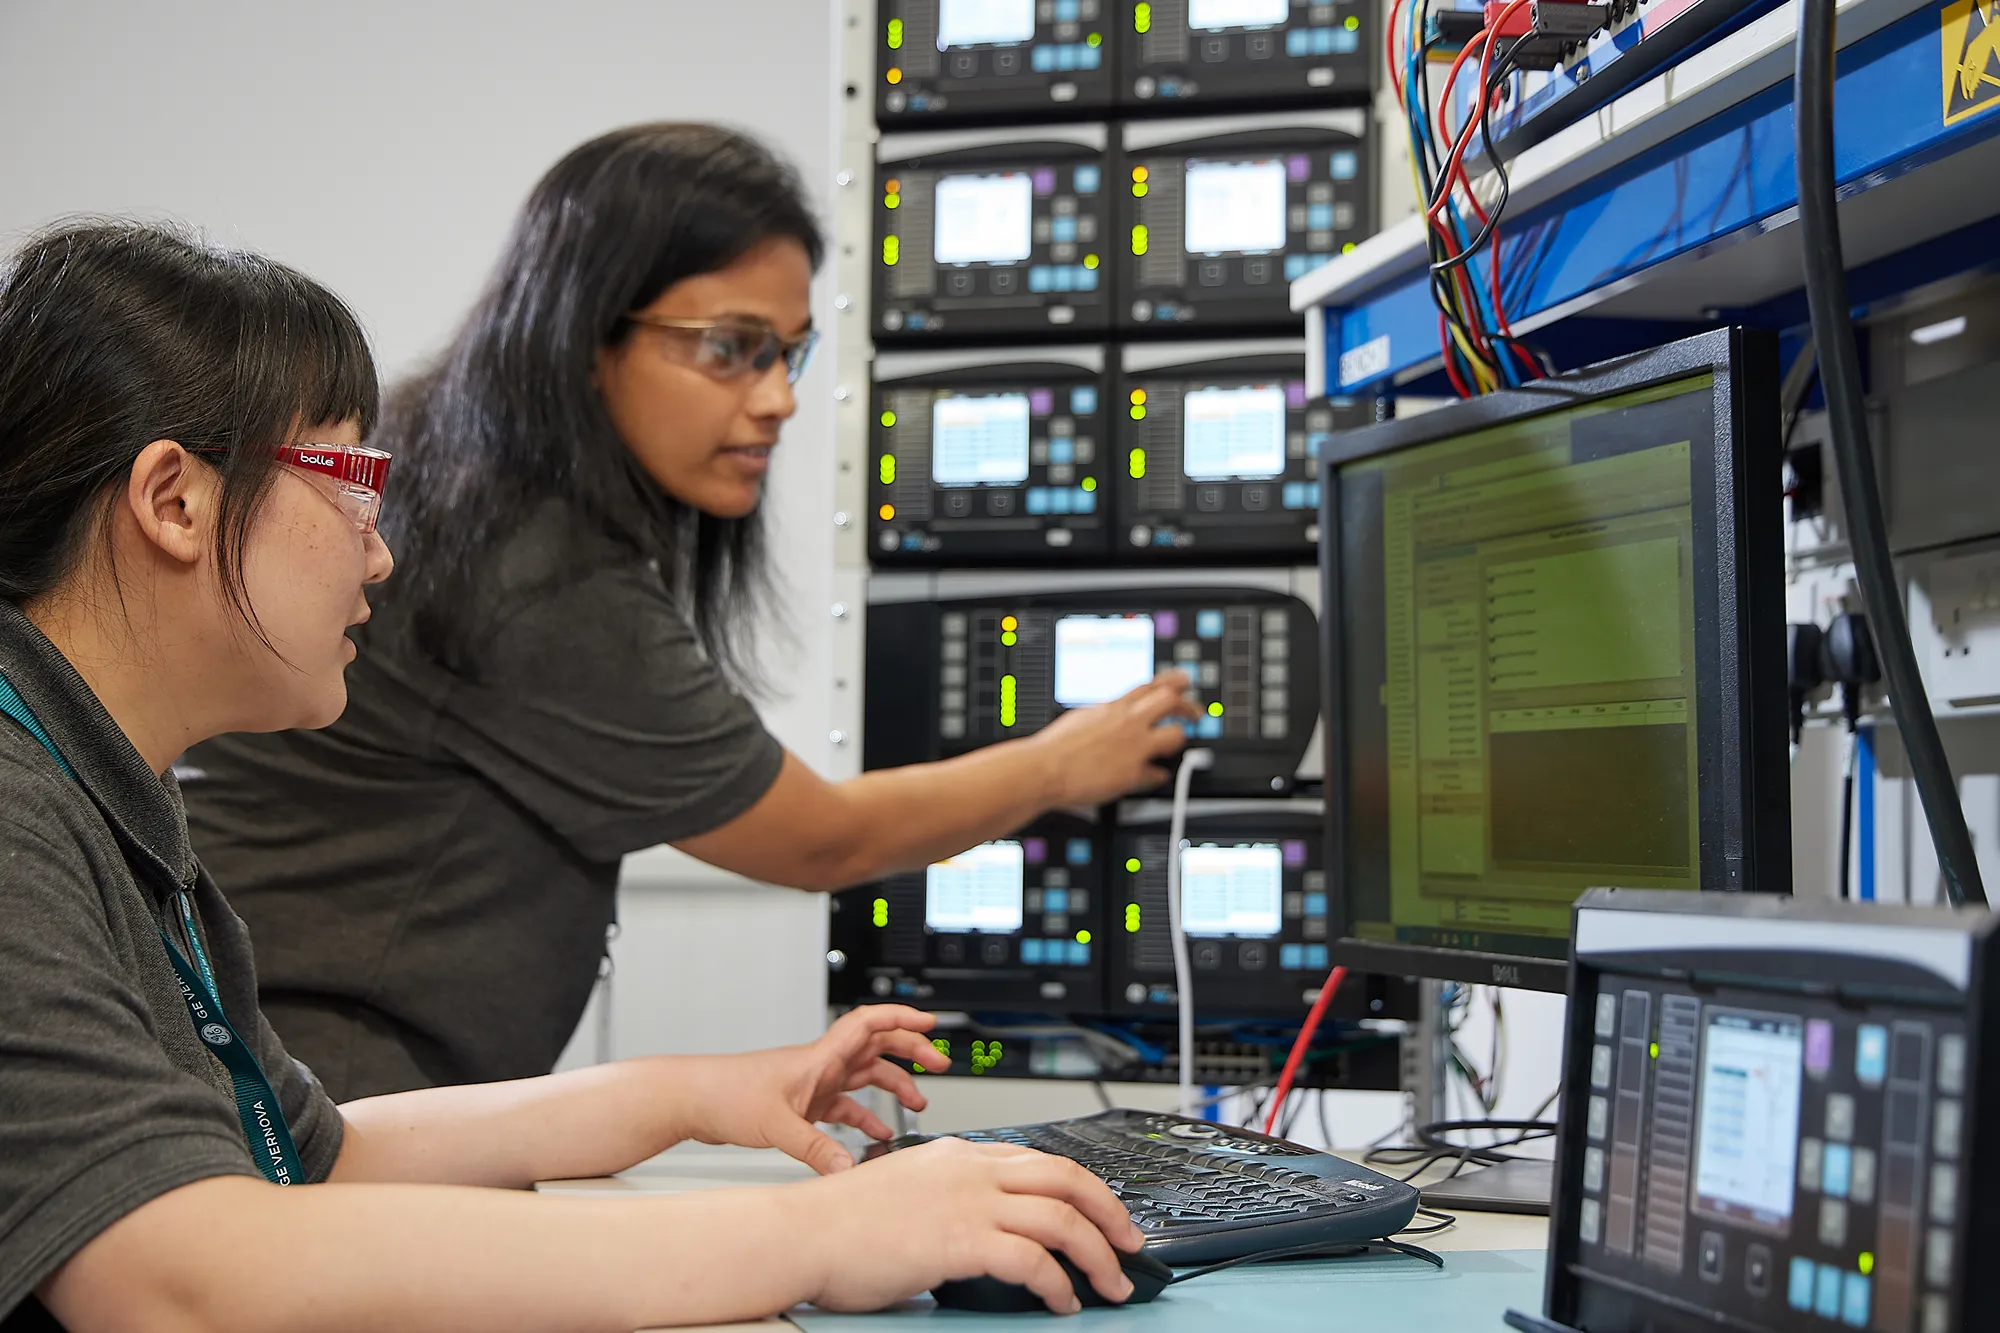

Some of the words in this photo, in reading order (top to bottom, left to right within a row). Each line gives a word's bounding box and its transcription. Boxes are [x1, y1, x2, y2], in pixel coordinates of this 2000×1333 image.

[300, 451, 334, 467] bollé
[191, 1001, 208, 1019] GE
[253, 1100, 283, 1166] VERNOVA
[275, 1166, 291, 1187] GE
